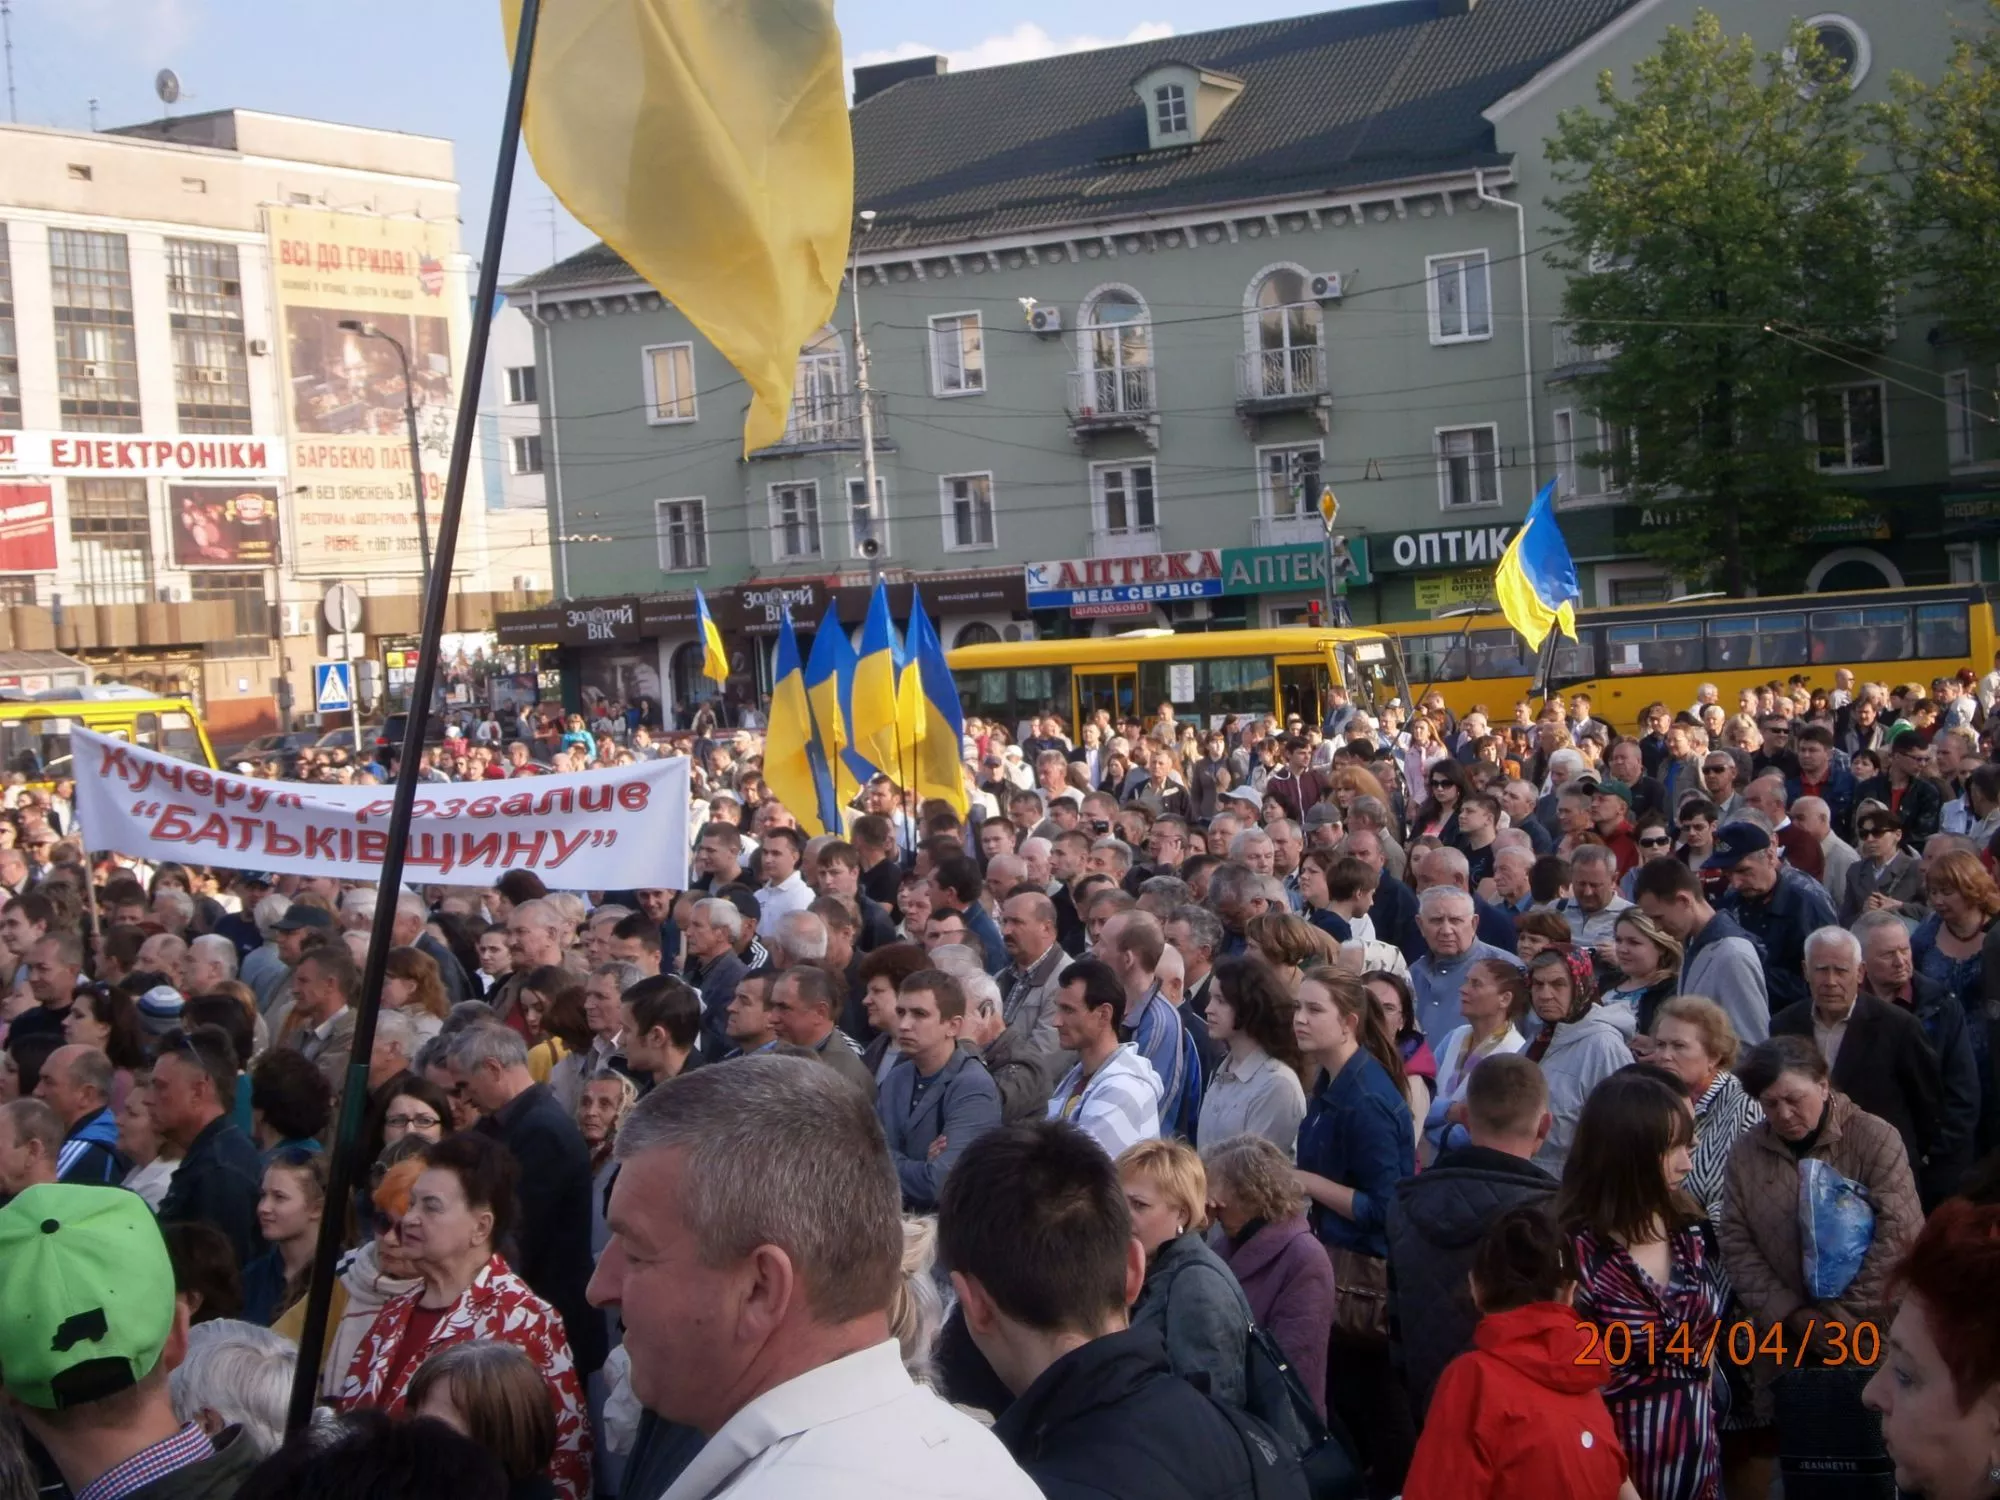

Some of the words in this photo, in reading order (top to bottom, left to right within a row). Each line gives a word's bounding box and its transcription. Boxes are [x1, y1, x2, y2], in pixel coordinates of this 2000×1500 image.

[51, 438, 266, 469] ЕЛЕКТРОНІКИ
[296, 445, 375, 469] БАРБЕКЮ
[381, 447, 415, 470] ПАТ
[1393, 527, 1518, 566] ОПТИК
[1055, 551, 1221, 588] АПТЕКА
[1075, 603, 1145, 616] ЦІЛОДОБОВО
[1799, 1460, 1857, 1471] JEANNETTE
